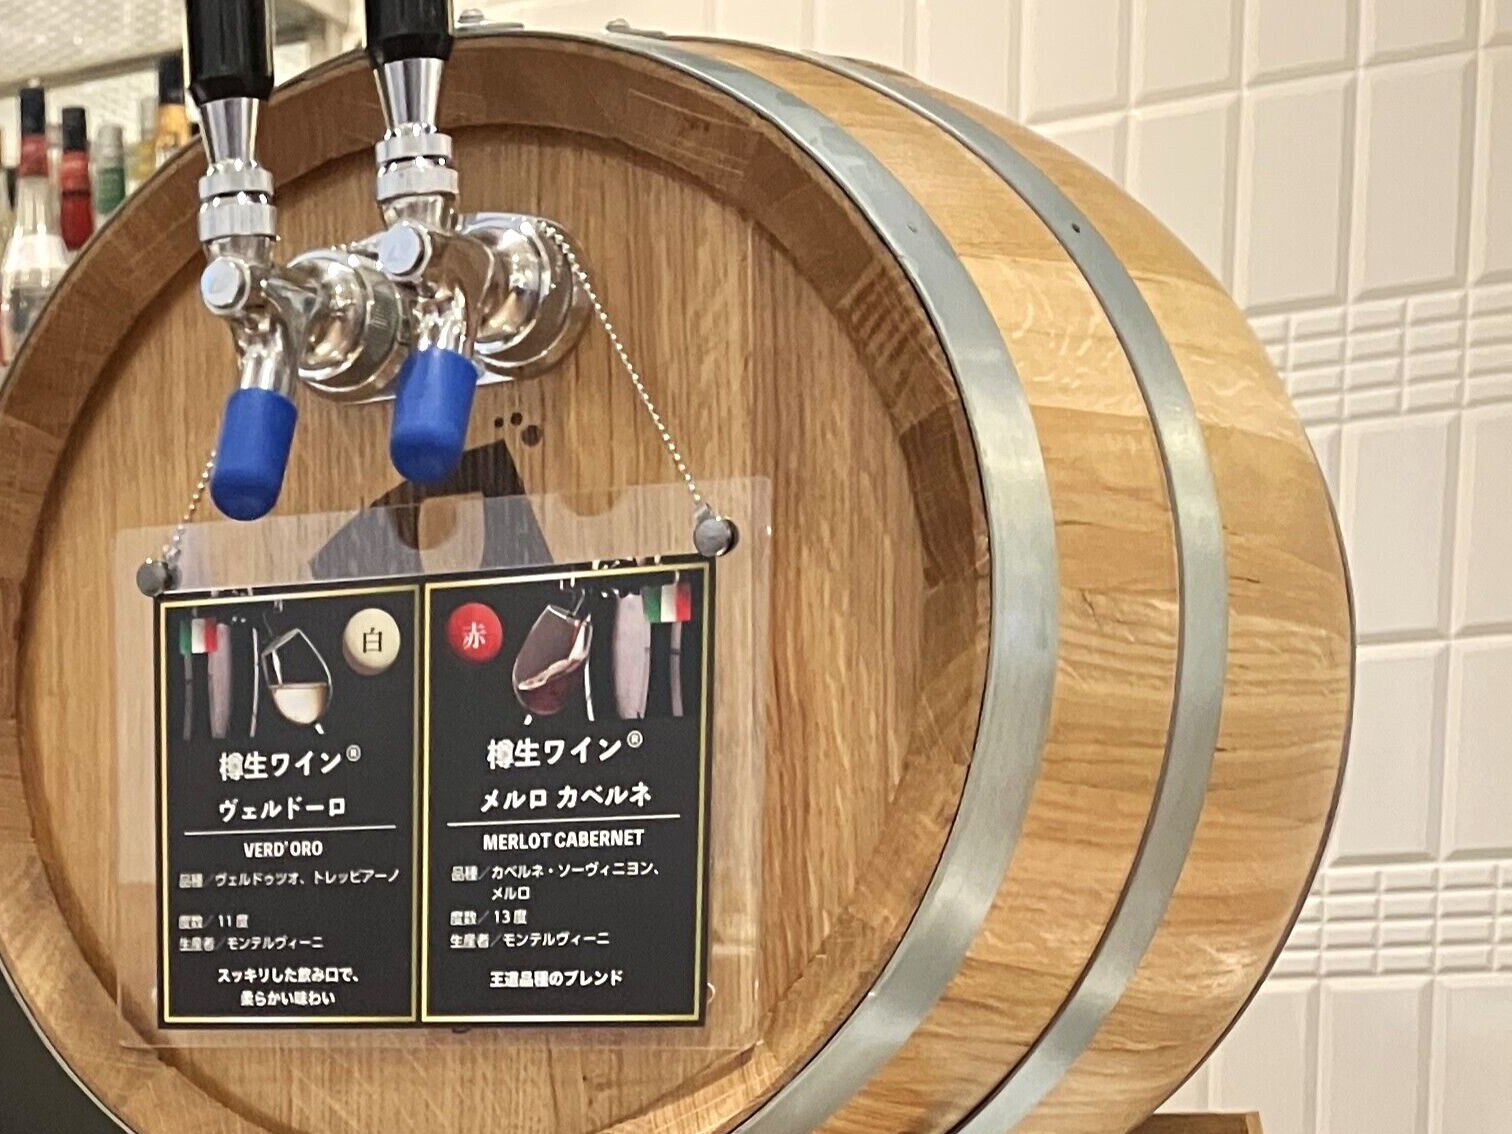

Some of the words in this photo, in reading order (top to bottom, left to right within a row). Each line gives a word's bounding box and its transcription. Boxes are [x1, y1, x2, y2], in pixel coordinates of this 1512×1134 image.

[361, 627, 383, 654] 白
[462, 621, 488, 650] 赤
[219, 796, 346, 823] ヴェルドーロ
[480, 788, 547, 813] メルロ
[556, 781, 652, 809] カベルネ
[483, 832, 552, 851] MERLOT
[554, 828, 645, 848] CABERNET
[491, 886, 531, 901] メルロ
